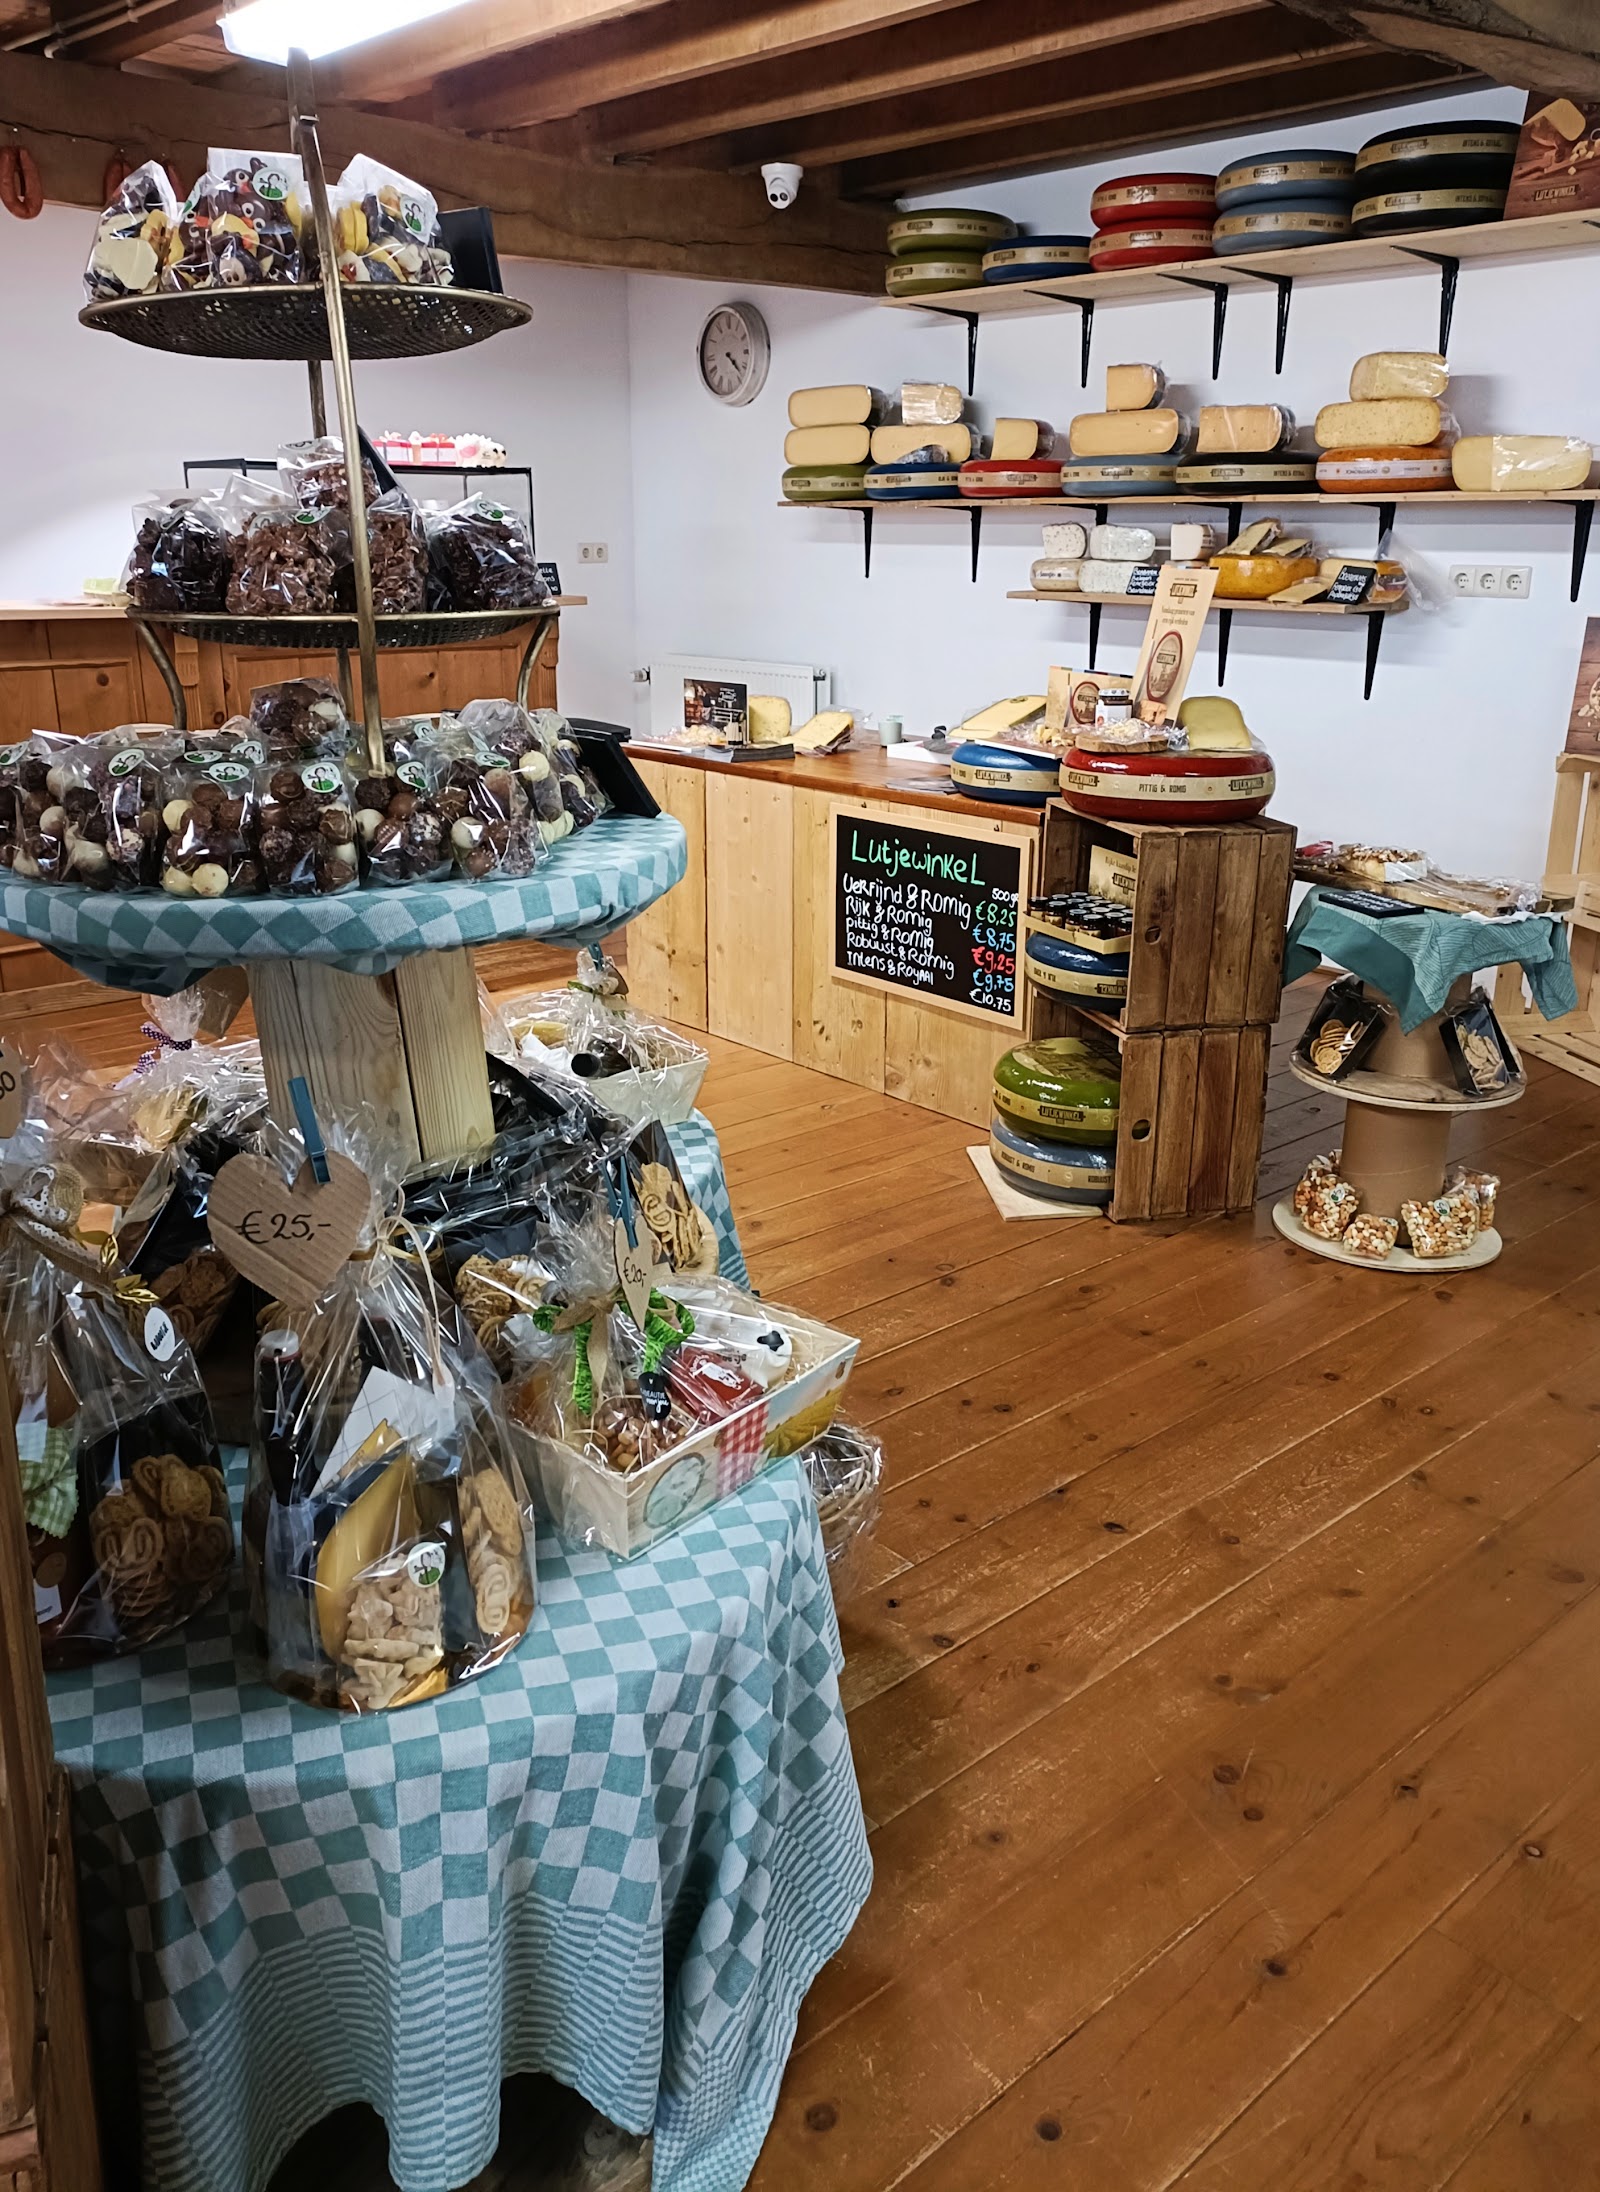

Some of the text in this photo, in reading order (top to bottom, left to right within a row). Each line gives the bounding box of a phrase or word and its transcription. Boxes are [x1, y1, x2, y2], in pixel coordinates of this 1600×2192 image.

[1138, 784, 1158, 793] PITTIG
[906, 883, 918, 909] &
[975, 901, 1016, 927] €8,25
[874, 903, 885, 923] &
[972, 923, 1015, 953] €8,75
[881, 924, 890, 940] &
[971, 946, 1015, 974] €9,25
[887, 959, 896, 975] &
[898, 946, 906, 961] &
[973, 969, 1014, 993] €9,75
[1041, 1106, 1082, 1121] LUTJEWINKEL
